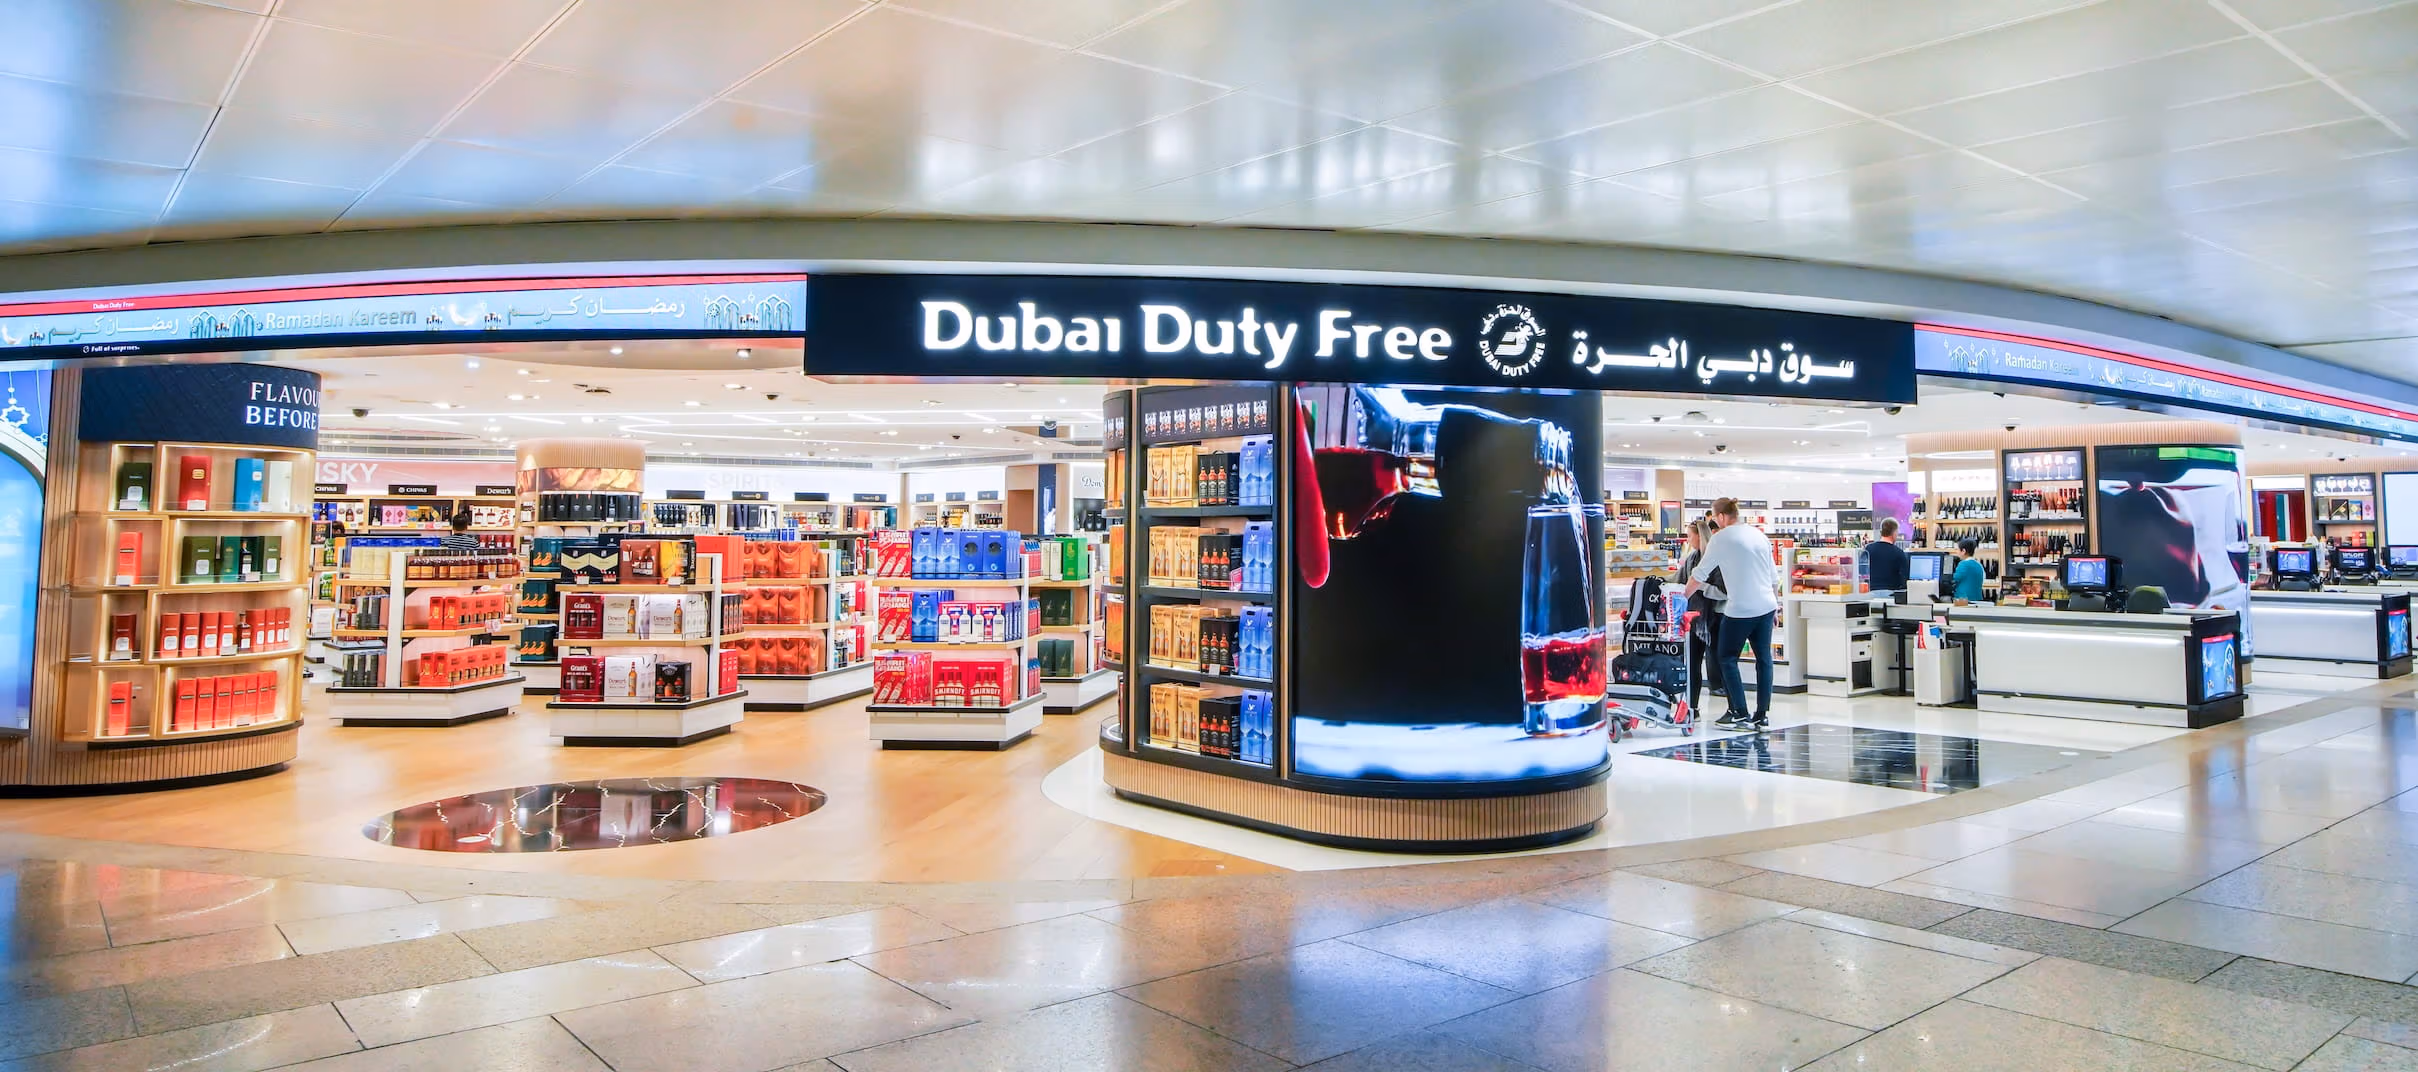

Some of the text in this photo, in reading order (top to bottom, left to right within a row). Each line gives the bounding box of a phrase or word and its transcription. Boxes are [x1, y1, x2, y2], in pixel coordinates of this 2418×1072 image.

[266, 307, 416, 330] Ramadan Kareem
[508, 294, 686, 326] رمضان كريم
[48, 315, 179, 344] رمضان كريم
[920, 301, 1453, 369] Dubai Duty Free
[1479, 340, 1546, 377] DUBAI DUTY FREE
[1572, 330, 1855, 384] سوق دبي الحرة
[2005, 352, 2048, 371] Ramadan
[250, 382, 320, 408] FLAVOU
[245, 405, 317, 430] BEFORE
[315, 462, 378, 483] ISKY
[934, 687, 965, 696] SMIRNOFF
[970, 687, 1001, 696] SMIRNOFF
